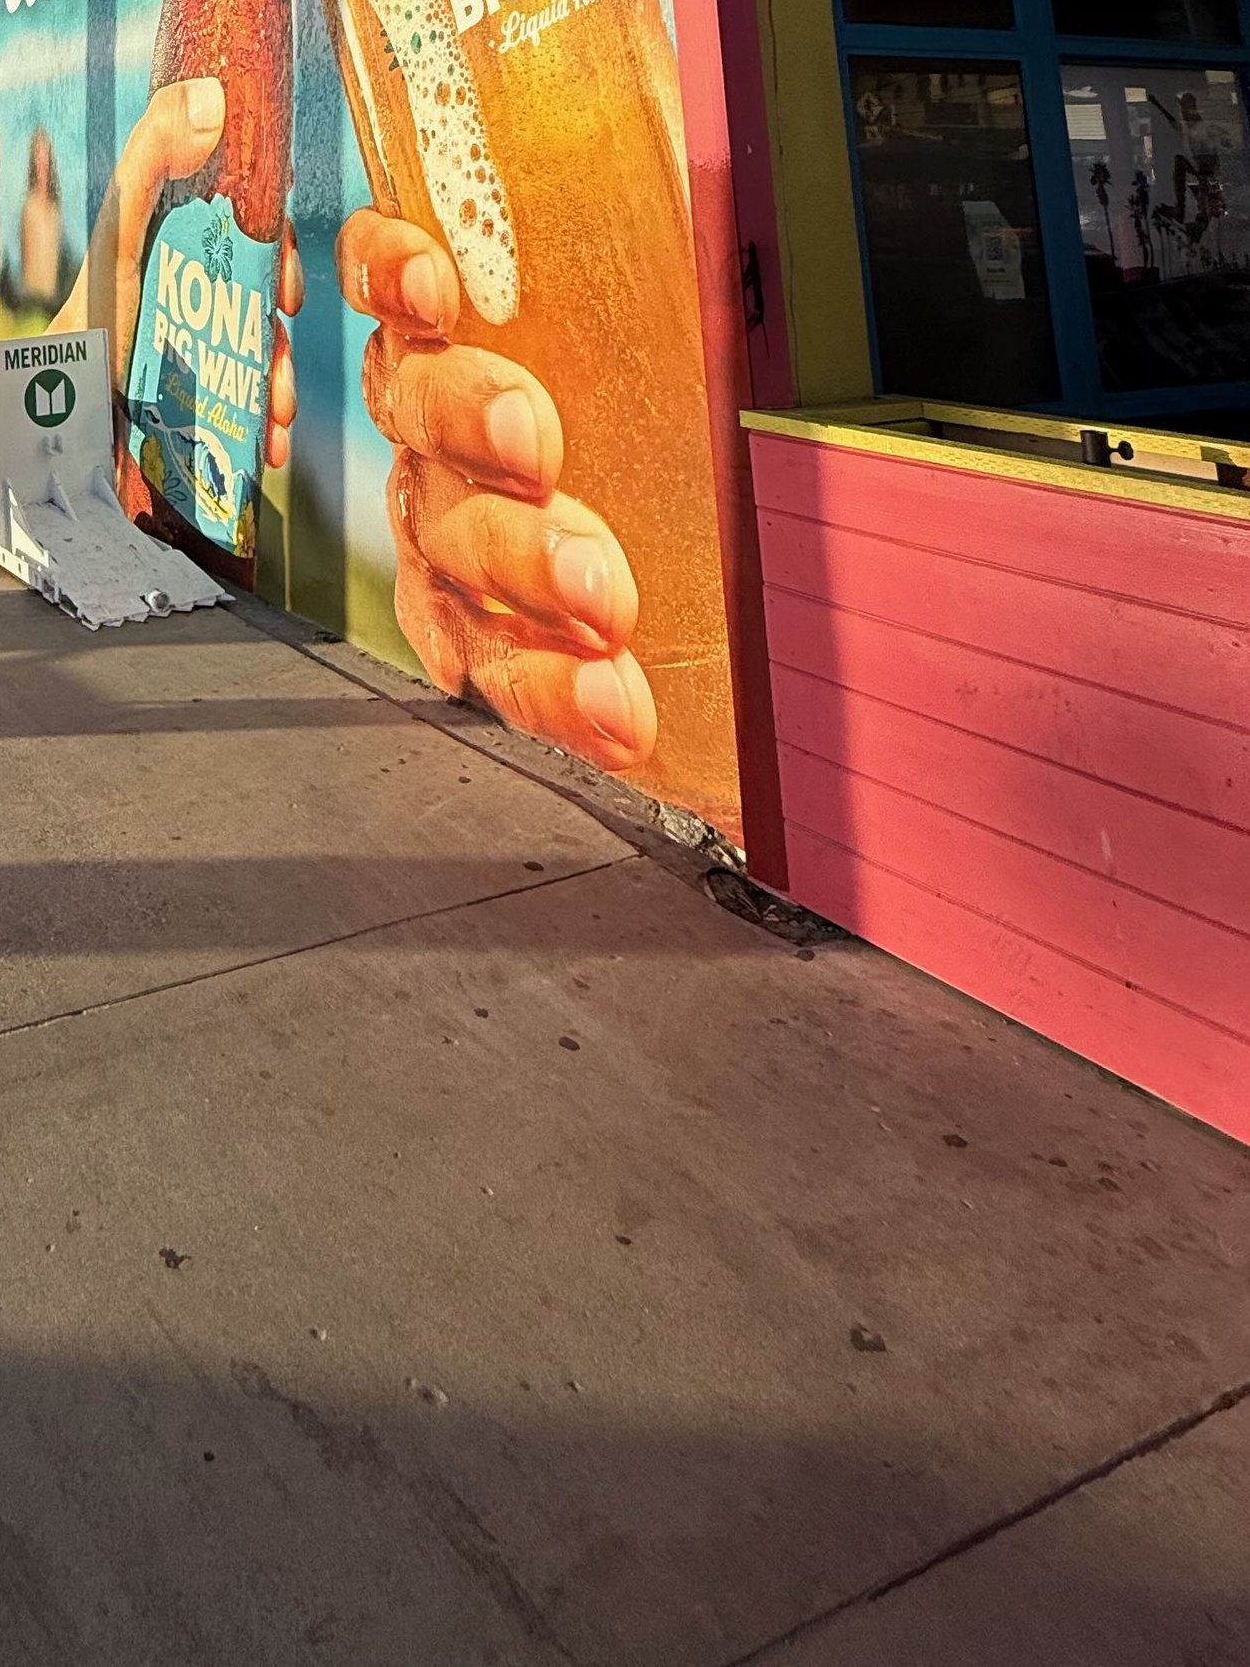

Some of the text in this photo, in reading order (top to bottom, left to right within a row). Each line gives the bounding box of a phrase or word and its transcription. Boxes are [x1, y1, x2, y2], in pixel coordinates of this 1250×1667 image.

[156, 239, 262, 364] KONA
[4, 340, 87, 370] MERIDIAN
[152, 308, 262, 416] BIG WAVE
[165, 371, 209, 419] Liquid
